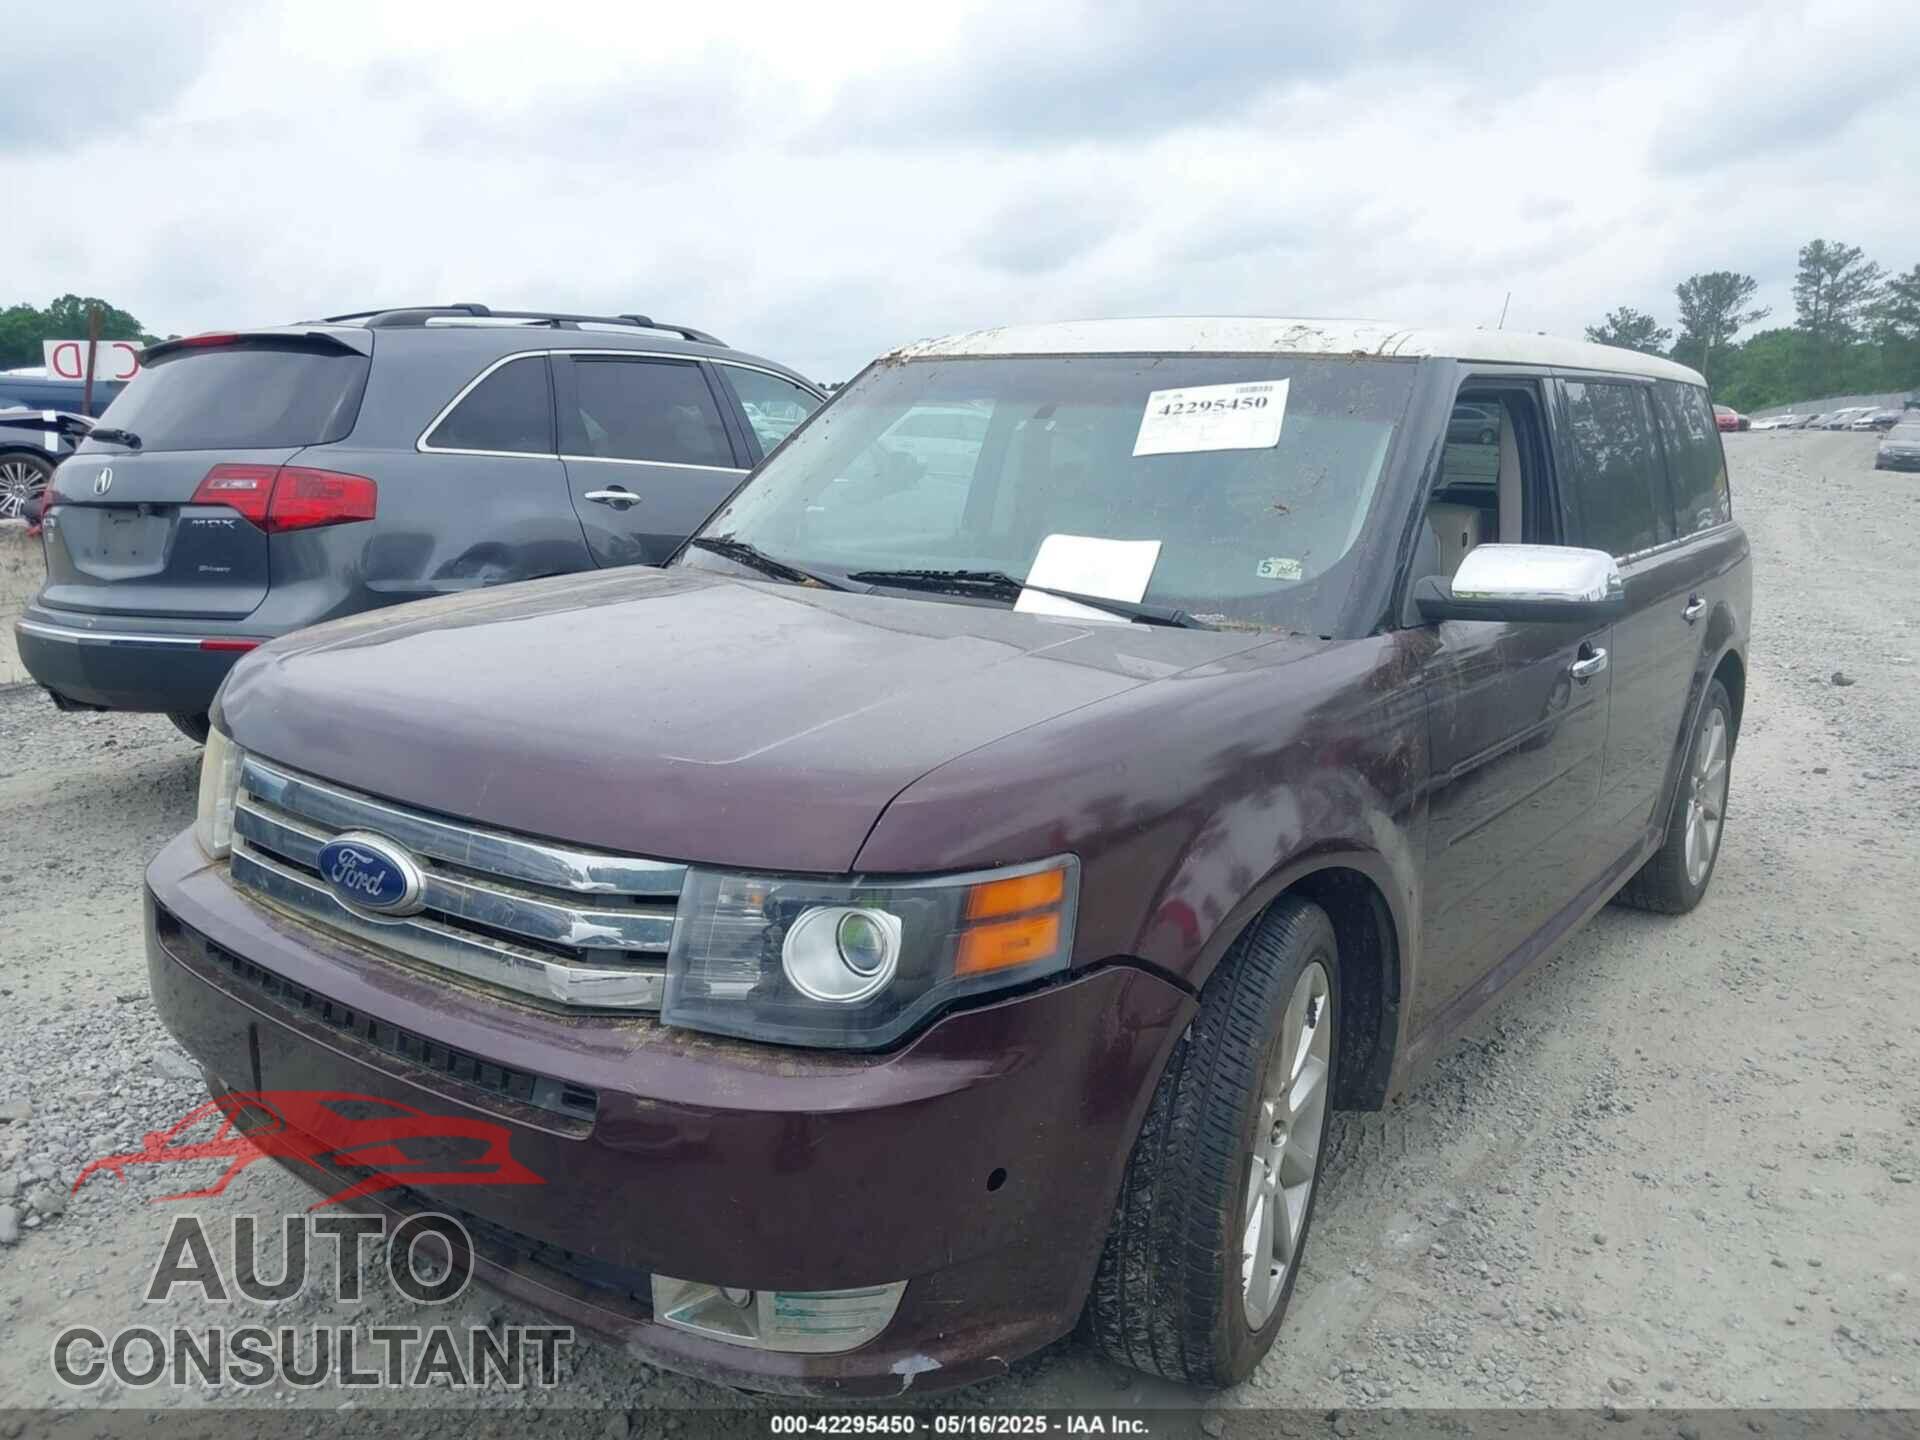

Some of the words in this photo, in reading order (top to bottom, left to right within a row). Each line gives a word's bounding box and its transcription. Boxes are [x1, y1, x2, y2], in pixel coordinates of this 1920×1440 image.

[1159, 397, 1268, 416] 42295450
[1262, 562, 1272, 574] 5
[332, 848, 386, 896] Ford
